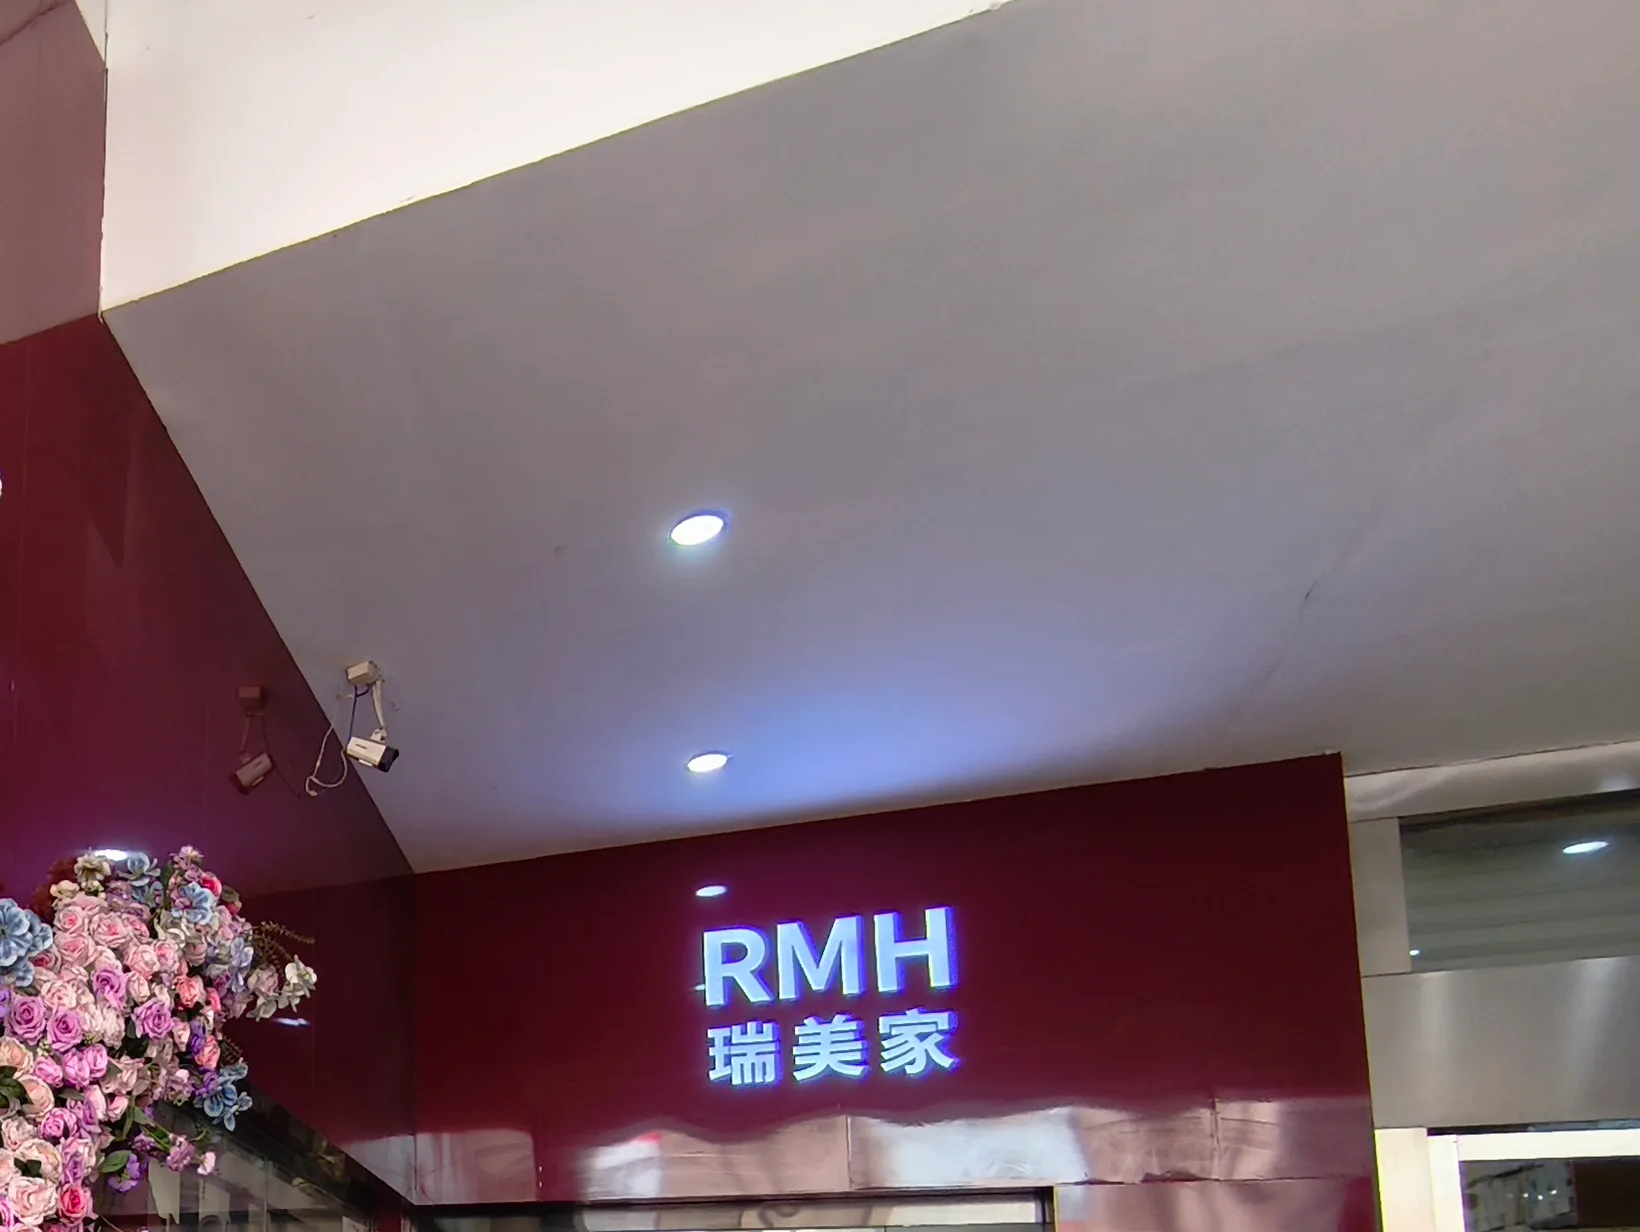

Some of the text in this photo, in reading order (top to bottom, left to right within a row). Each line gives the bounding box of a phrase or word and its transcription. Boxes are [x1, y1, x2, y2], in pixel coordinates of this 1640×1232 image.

[702, 905, 958, 1006] RMH
[706, 1008, 958, 1086] 瑞美家
